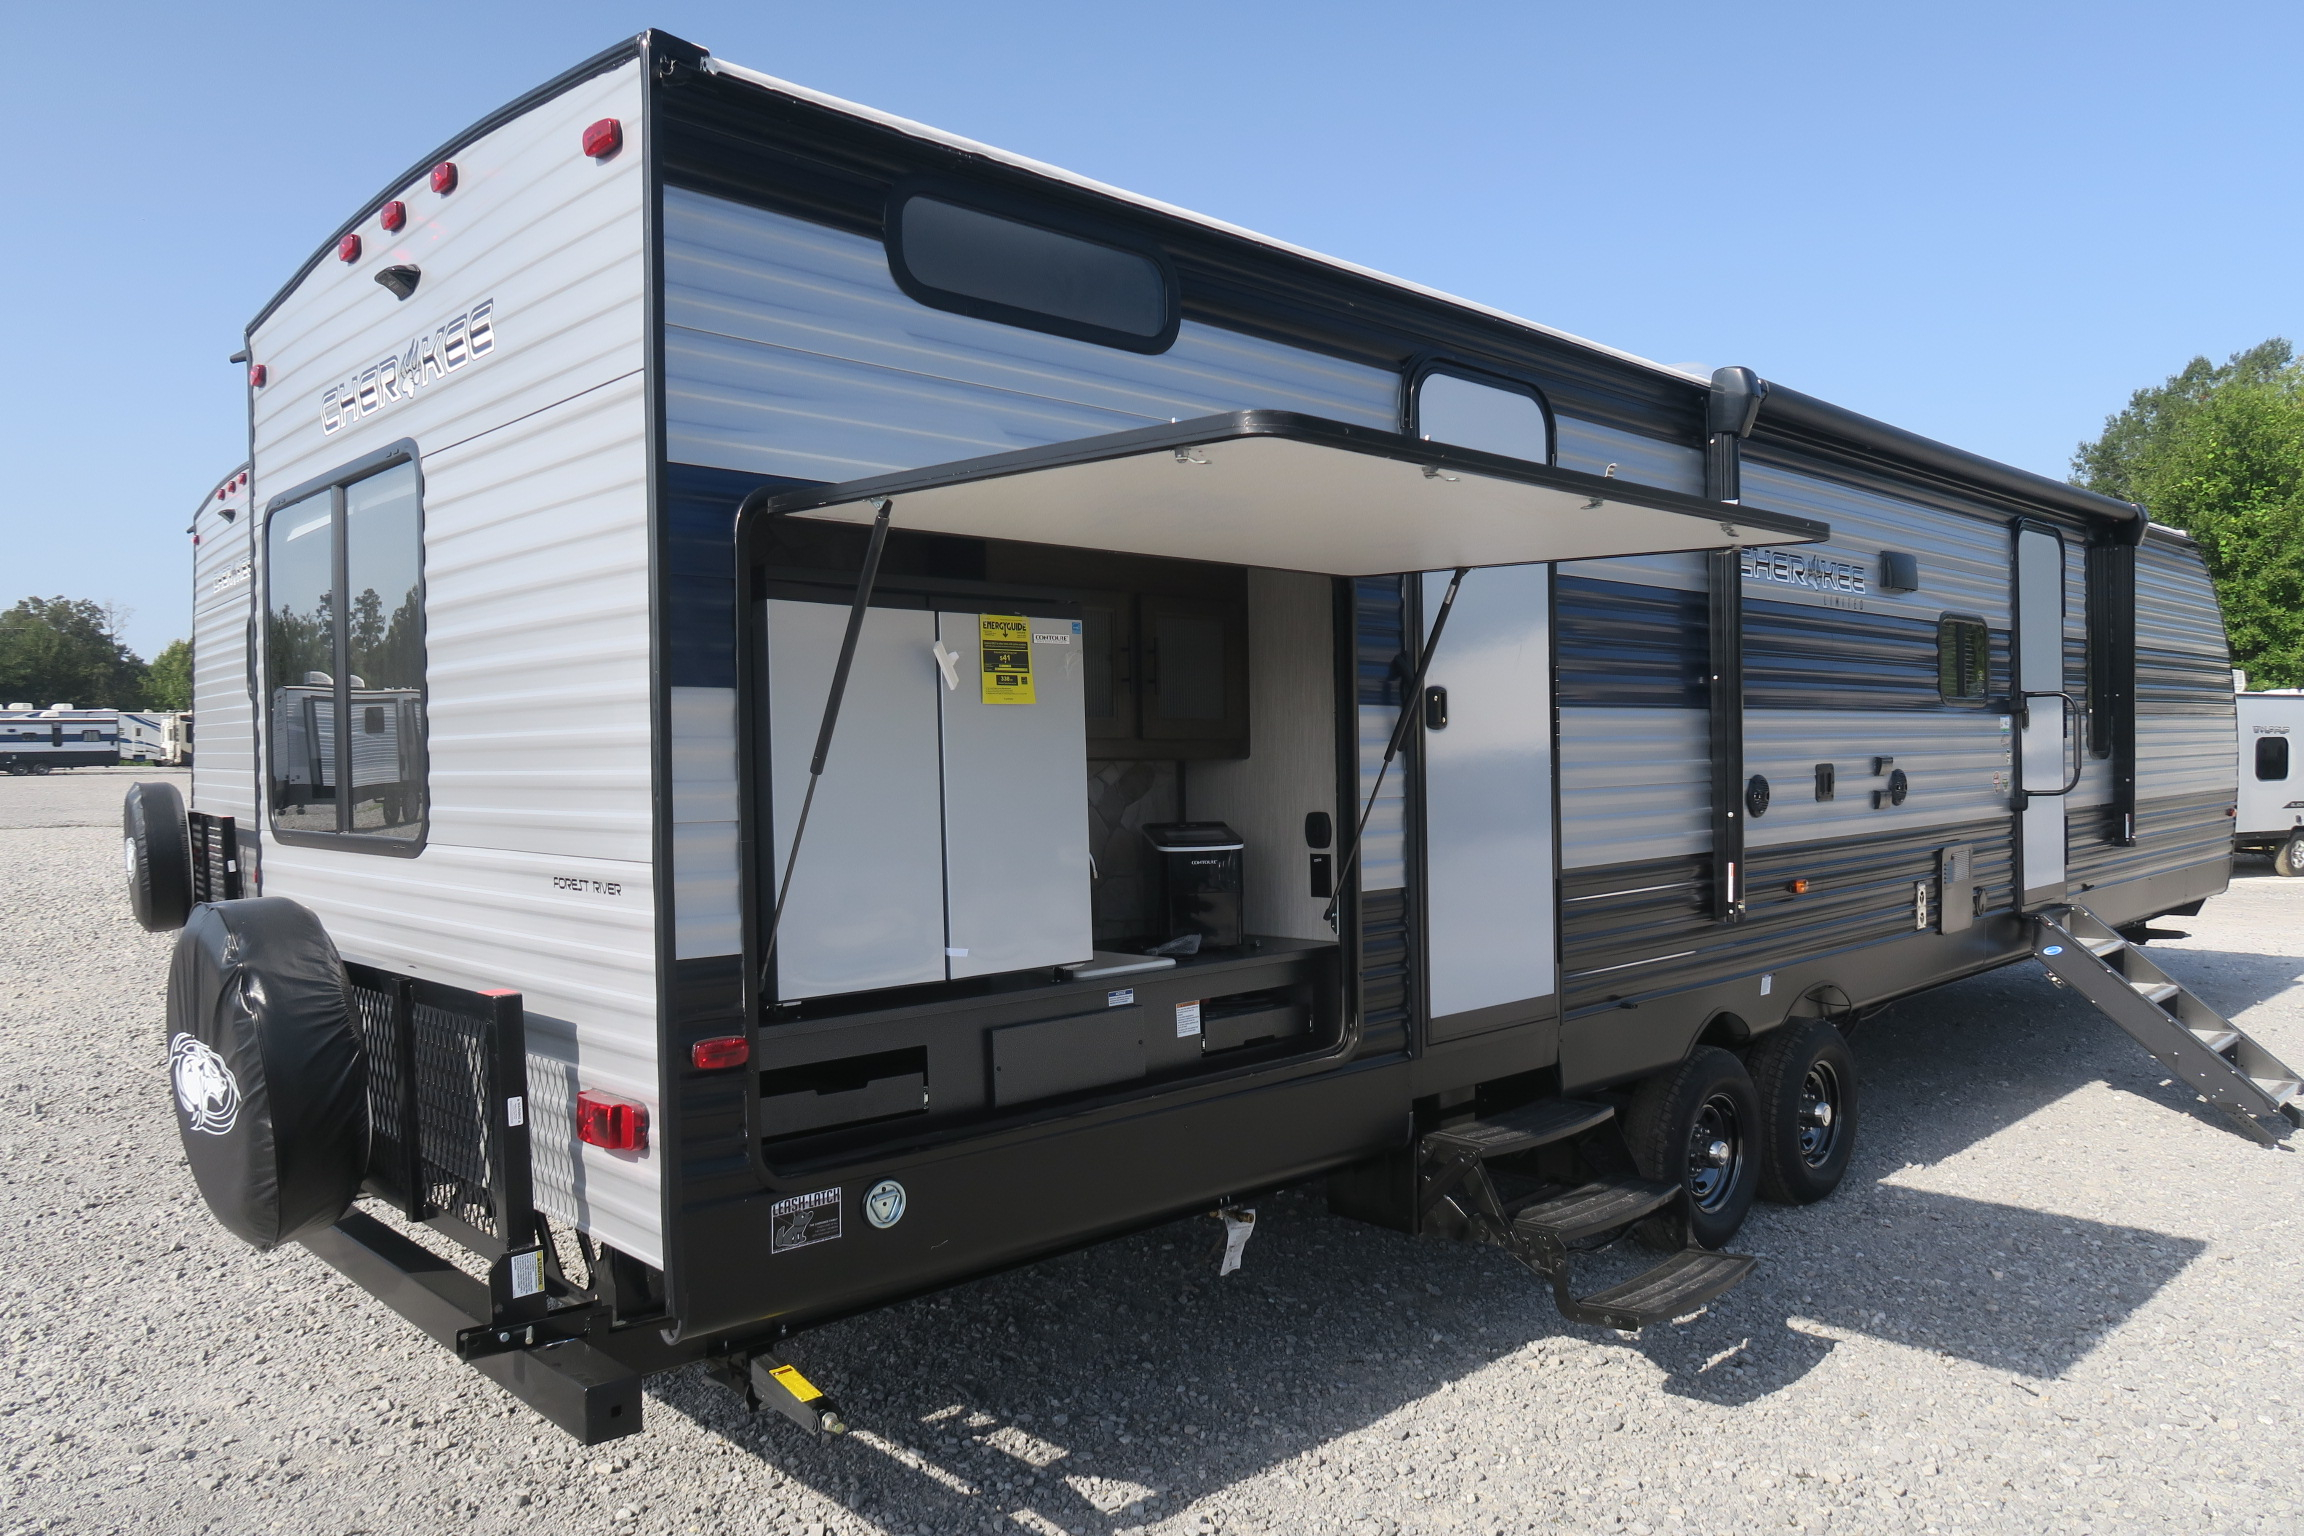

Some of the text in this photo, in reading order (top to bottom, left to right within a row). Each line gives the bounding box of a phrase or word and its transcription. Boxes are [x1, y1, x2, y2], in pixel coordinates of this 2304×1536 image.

[320, 298, 495, 436] CHEROKEE
[1823, 595, 1864, 611] LIMITED
[553, 876, 622, 896] FOREST RIVER
